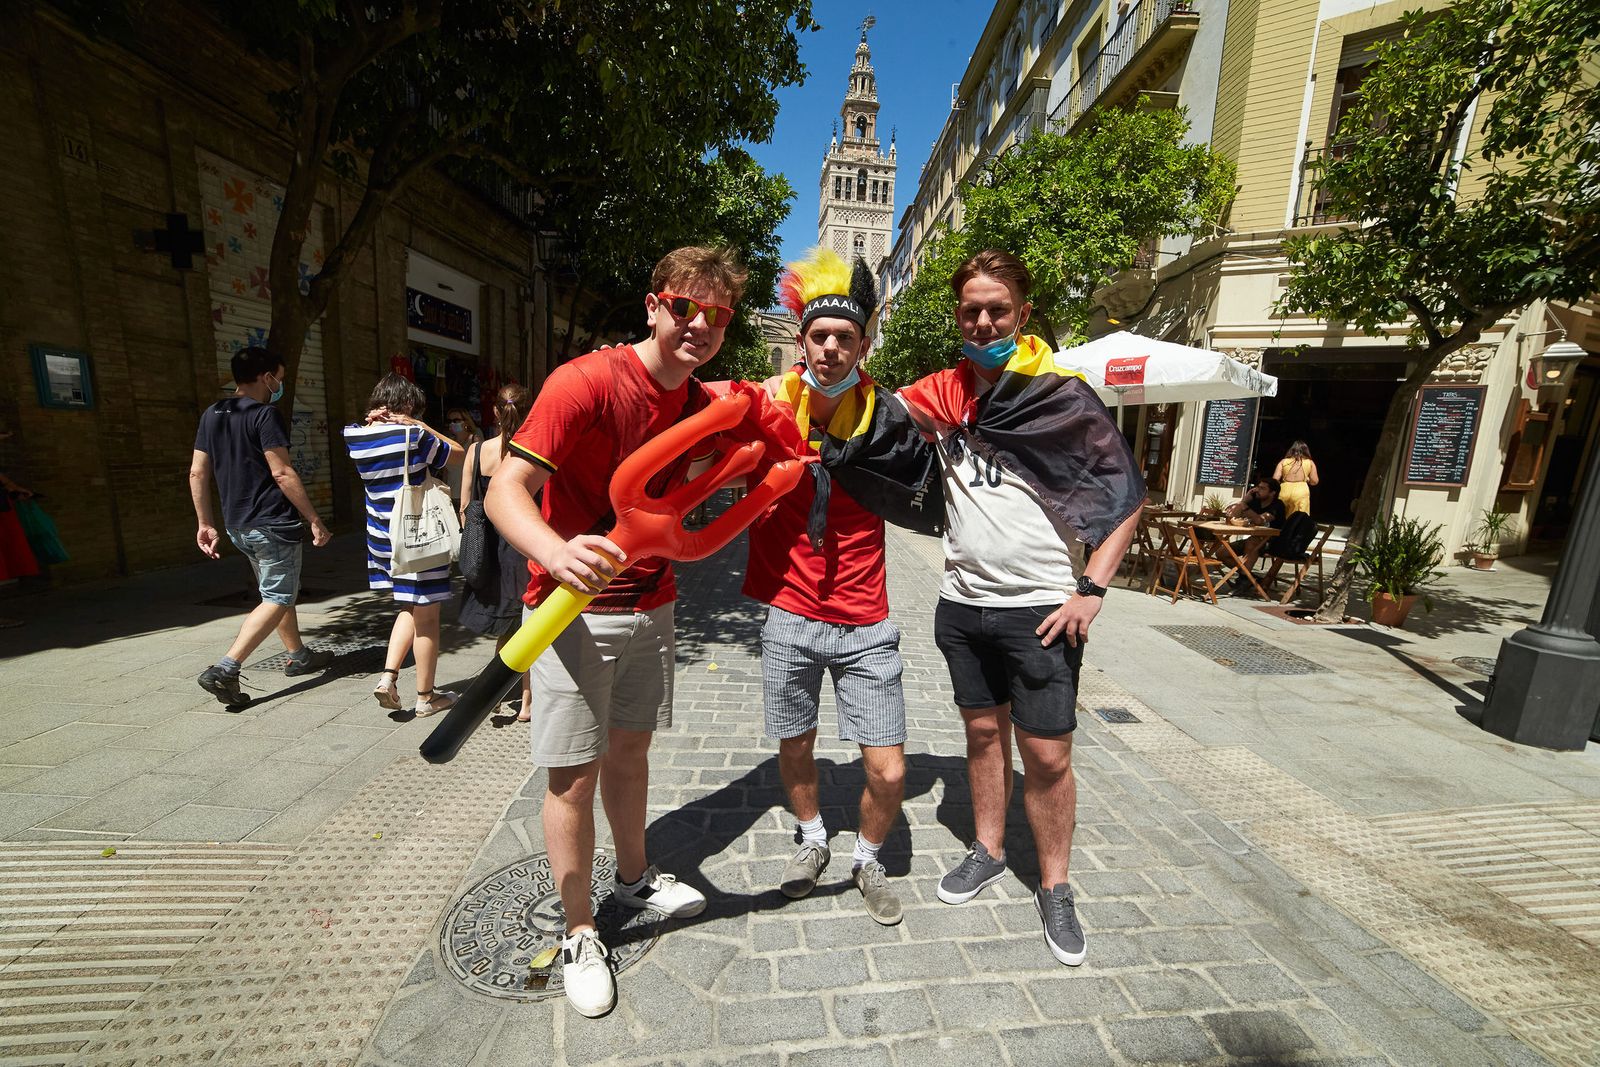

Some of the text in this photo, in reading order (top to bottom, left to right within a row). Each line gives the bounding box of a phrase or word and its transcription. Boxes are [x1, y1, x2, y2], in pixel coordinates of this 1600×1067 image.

[1108, 364, 1142, 373] Cruzcampo
[969, 450, 1002, 488] 10
[481, 883, 523, 949] SANEAMIENTO
